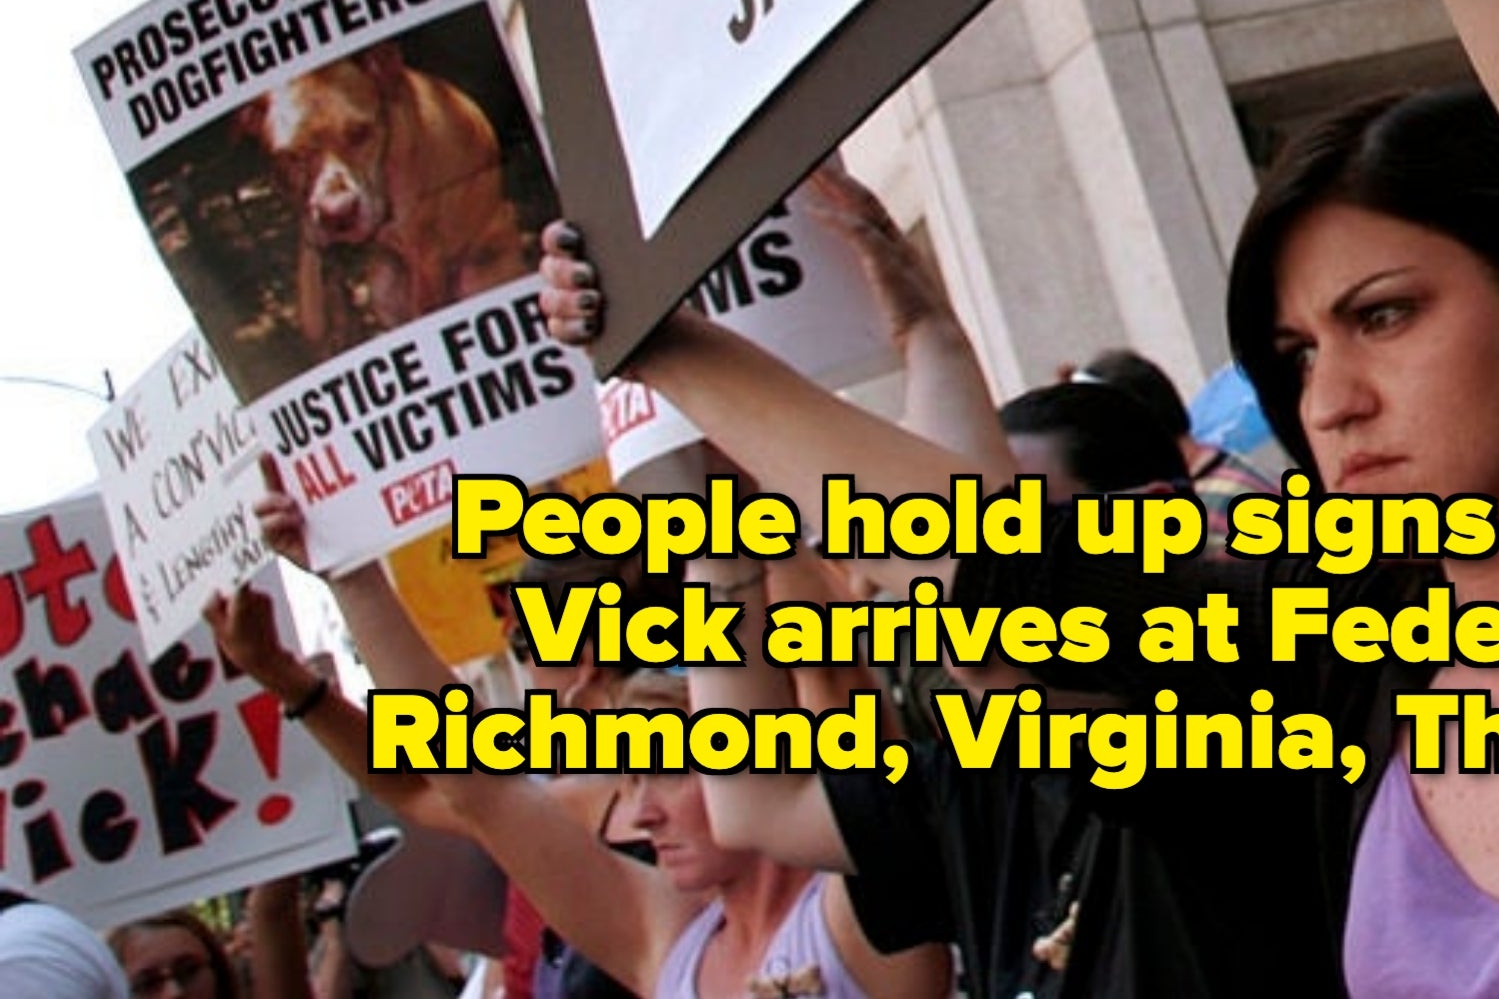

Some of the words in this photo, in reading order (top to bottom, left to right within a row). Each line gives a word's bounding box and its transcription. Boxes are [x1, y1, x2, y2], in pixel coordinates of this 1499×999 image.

[270, 341, 431, 457] JUSTICE
[440, 290, 555, 375] FOR
[294, 444, 356, 505] ALL
[351, 345, 577, 472] VICTIMS
